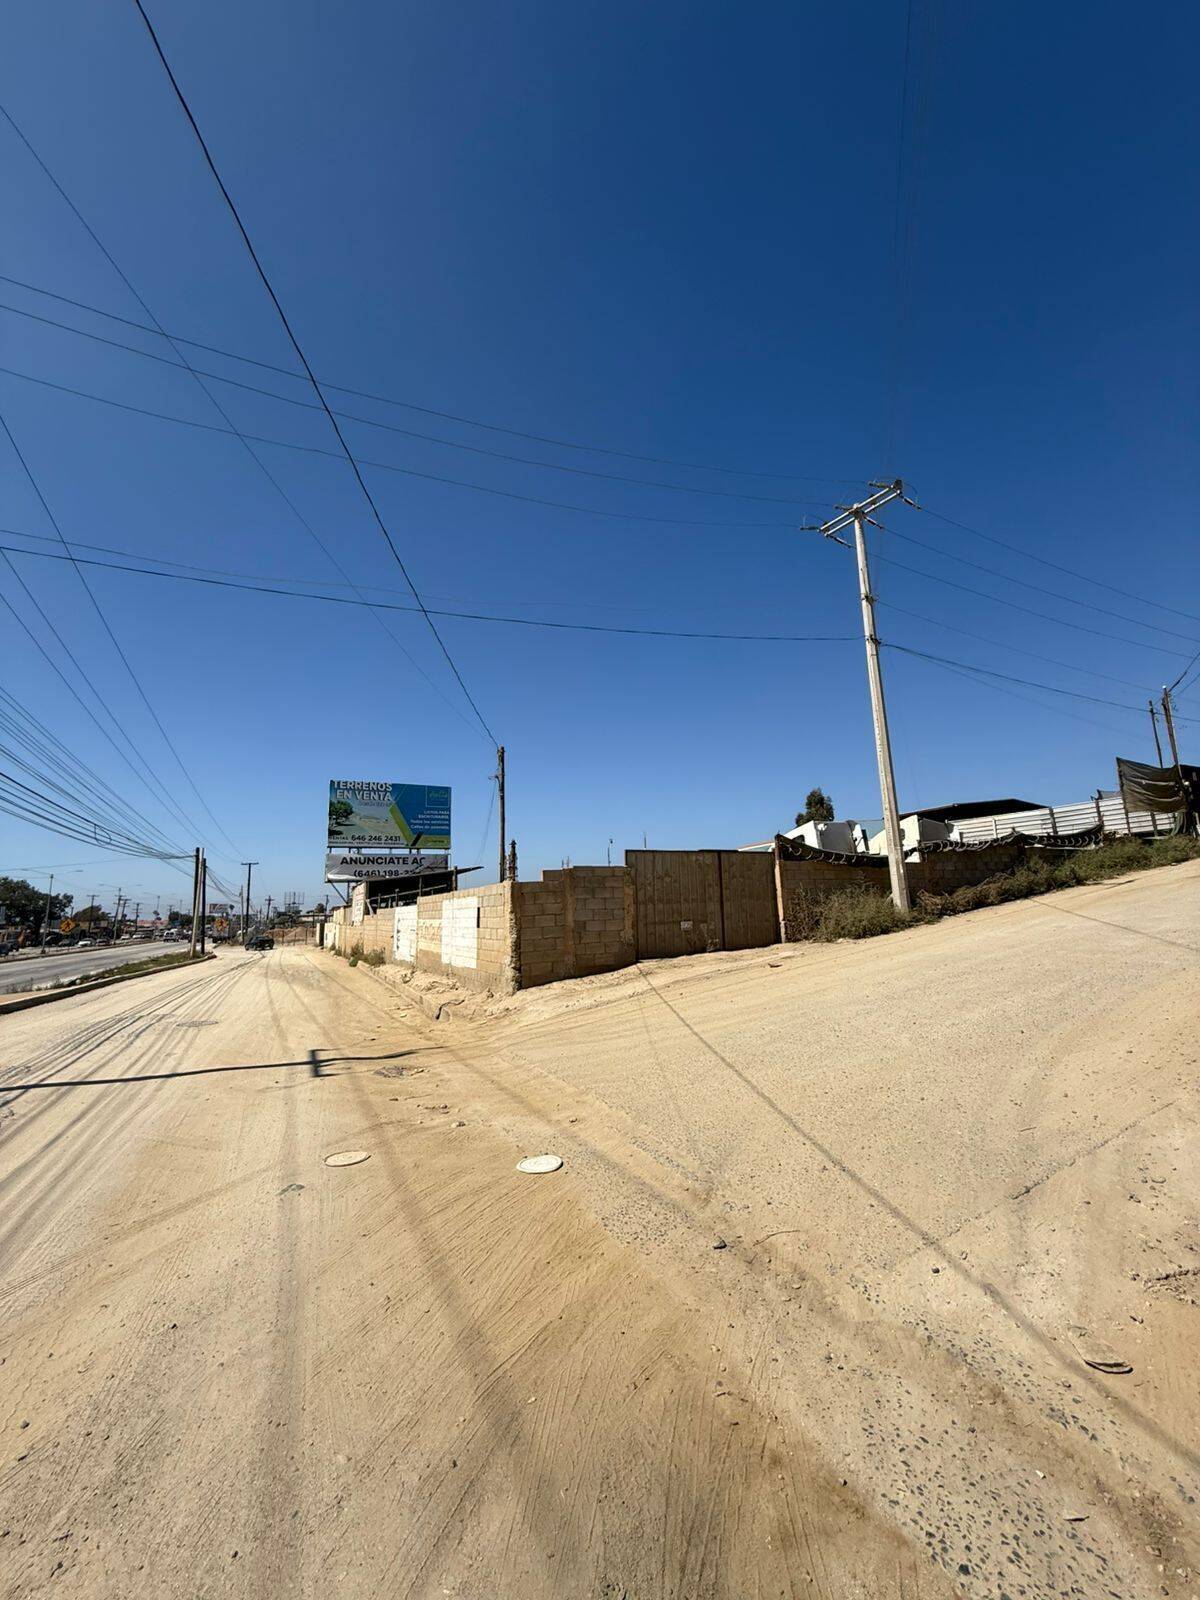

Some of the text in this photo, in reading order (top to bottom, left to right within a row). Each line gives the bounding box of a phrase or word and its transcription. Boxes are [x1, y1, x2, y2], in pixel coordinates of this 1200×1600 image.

[333, 780, 393, 791] TERRENOS
[336, 789, 393, 801] EN VENTA
[340, 856, 409, 865] ANUNCIATE
